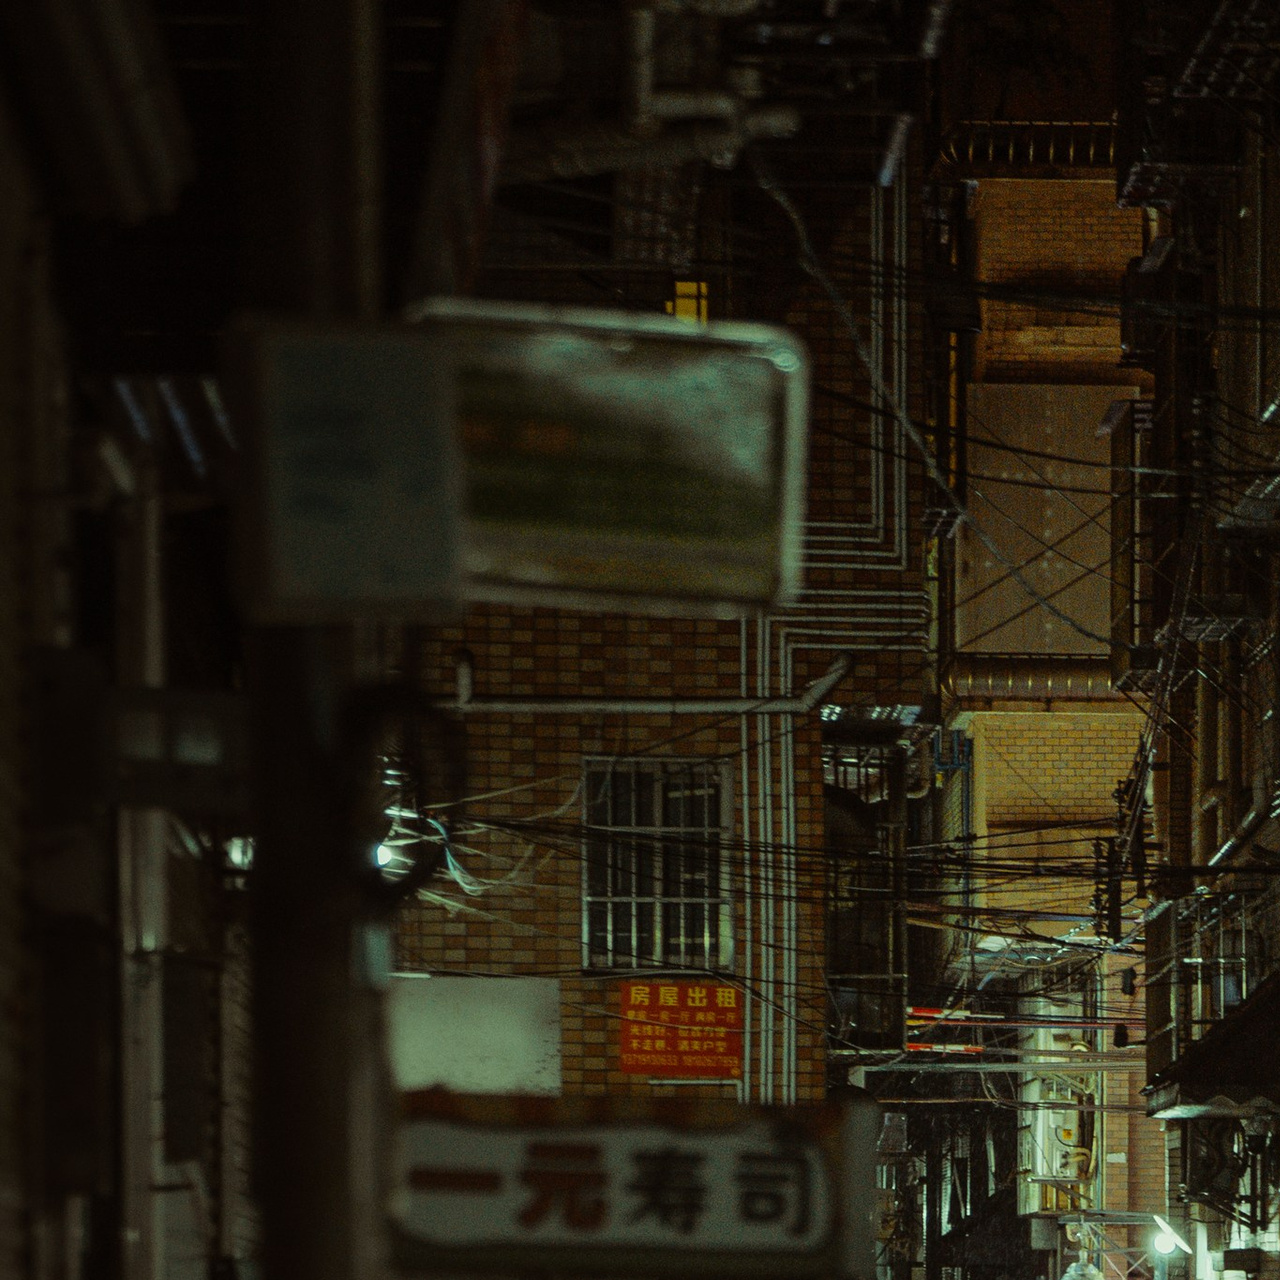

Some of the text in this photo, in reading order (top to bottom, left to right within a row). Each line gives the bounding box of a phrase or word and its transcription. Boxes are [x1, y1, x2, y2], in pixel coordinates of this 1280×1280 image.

[630, 985, 737, 1008] 房屋出租
[408, 1141, 813, 1238] 一元寿司
